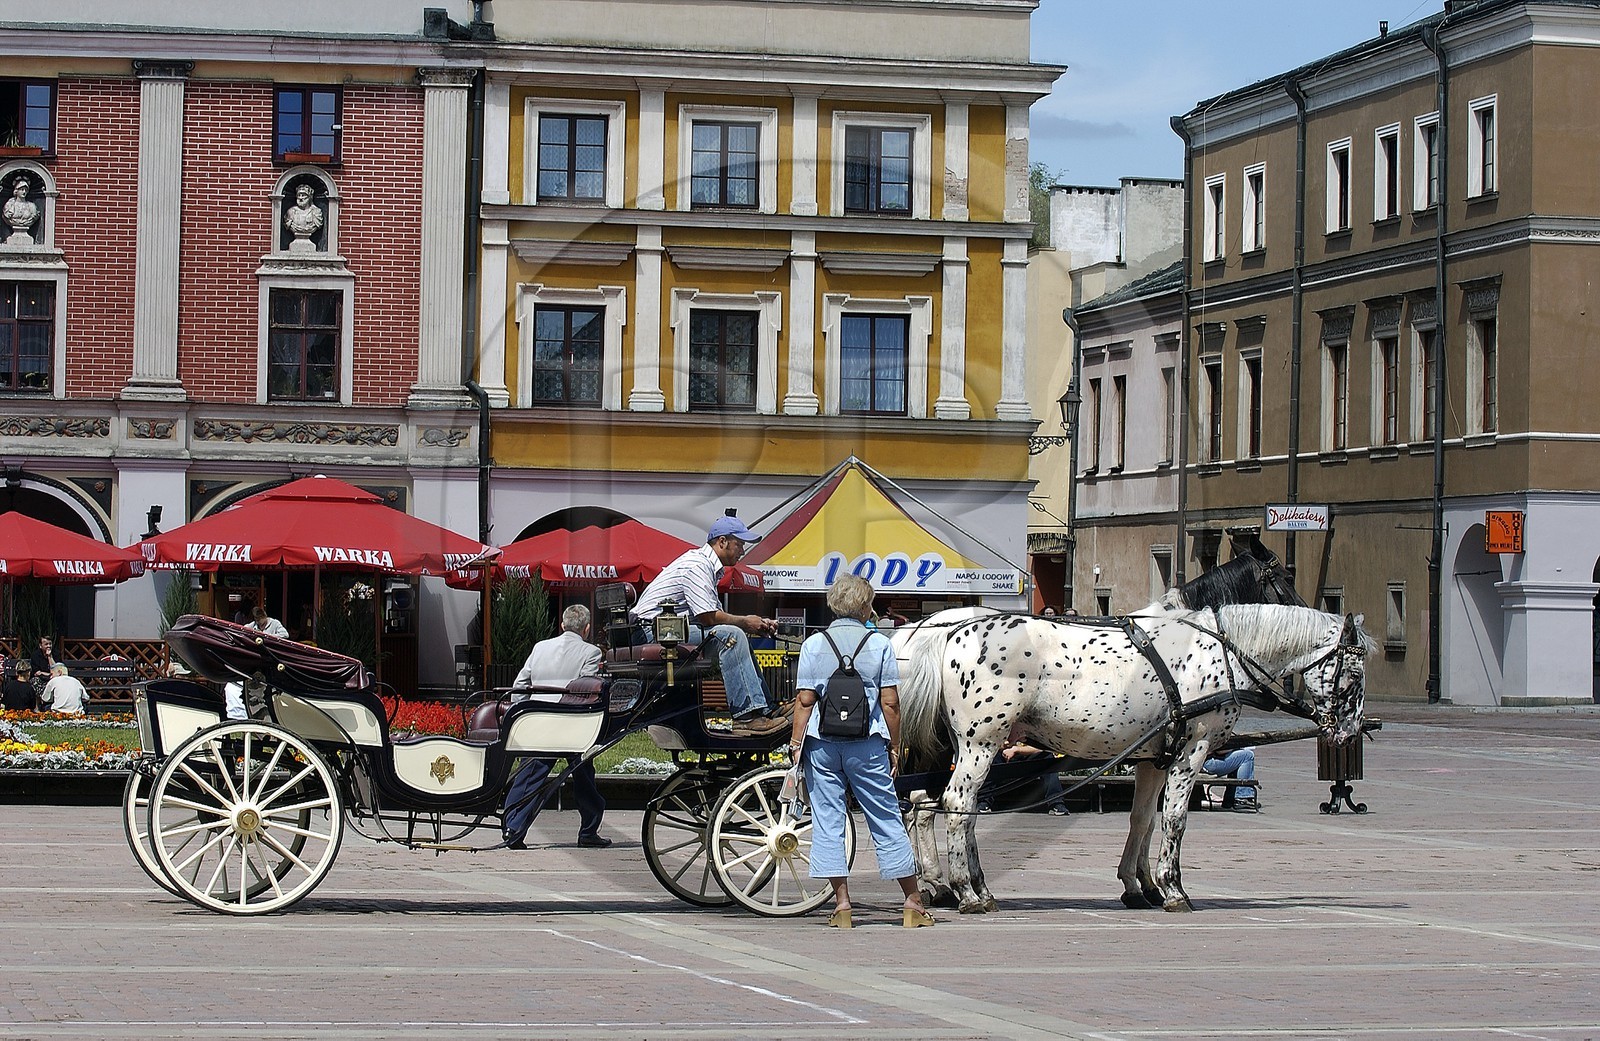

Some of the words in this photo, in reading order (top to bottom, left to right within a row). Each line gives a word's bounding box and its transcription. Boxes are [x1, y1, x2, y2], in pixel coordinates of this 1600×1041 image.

[1268, 507, 1326, 529] Delikatesy
[1512, 513, 1521, 551] HOTEL
[186, 543, 252, 563] WARKA
[314, 546, 394, 568] WARKA
[53, 560, 105, 575] WARKA
[562, 564, 618, 579] WARKA
[955, 571, 980, 580] NAPÓJ
[982, 573, 1015, 581] LODOWY
